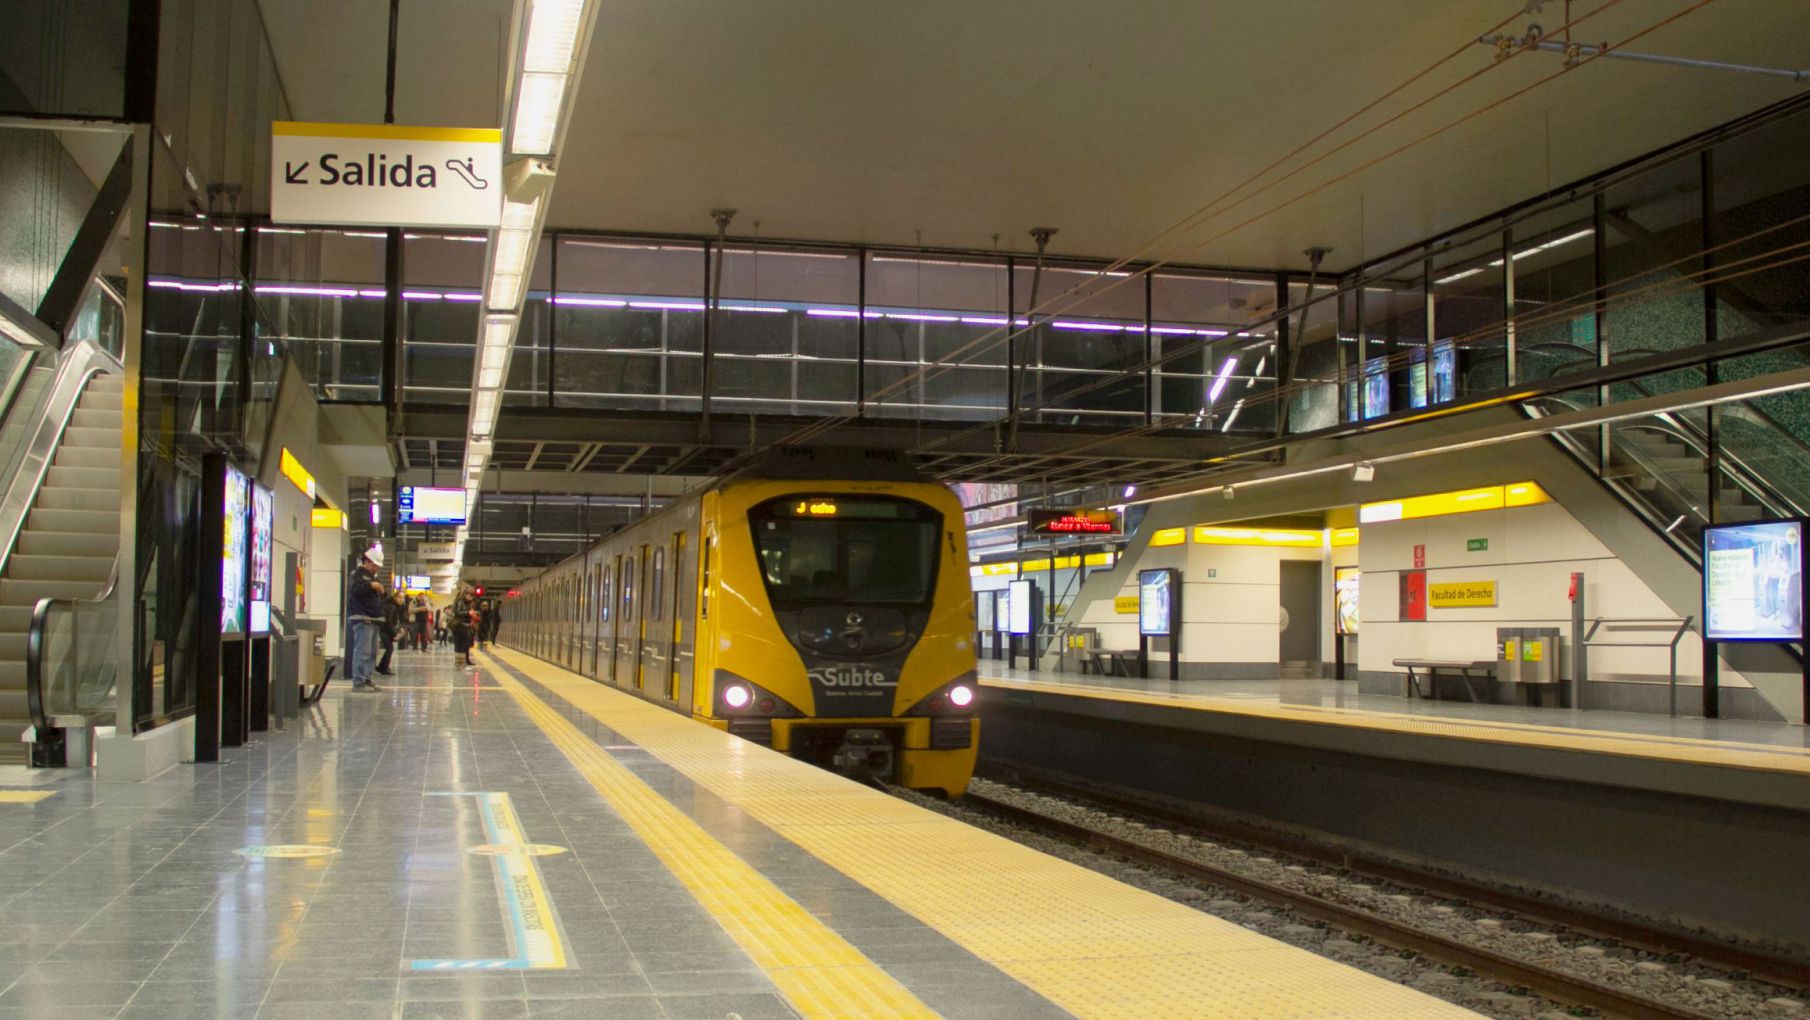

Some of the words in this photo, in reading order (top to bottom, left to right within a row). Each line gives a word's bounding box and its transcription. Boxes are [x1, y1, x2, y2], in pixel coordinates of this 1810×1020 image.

[319, 153, 437, 188] Salida
[1431, 590, 1456, 600] Facultad
[1457, 590, 1465, 599] de
[1466, 588, 1492, 599] Derecho
[824, 668, 885, 686] Subte
